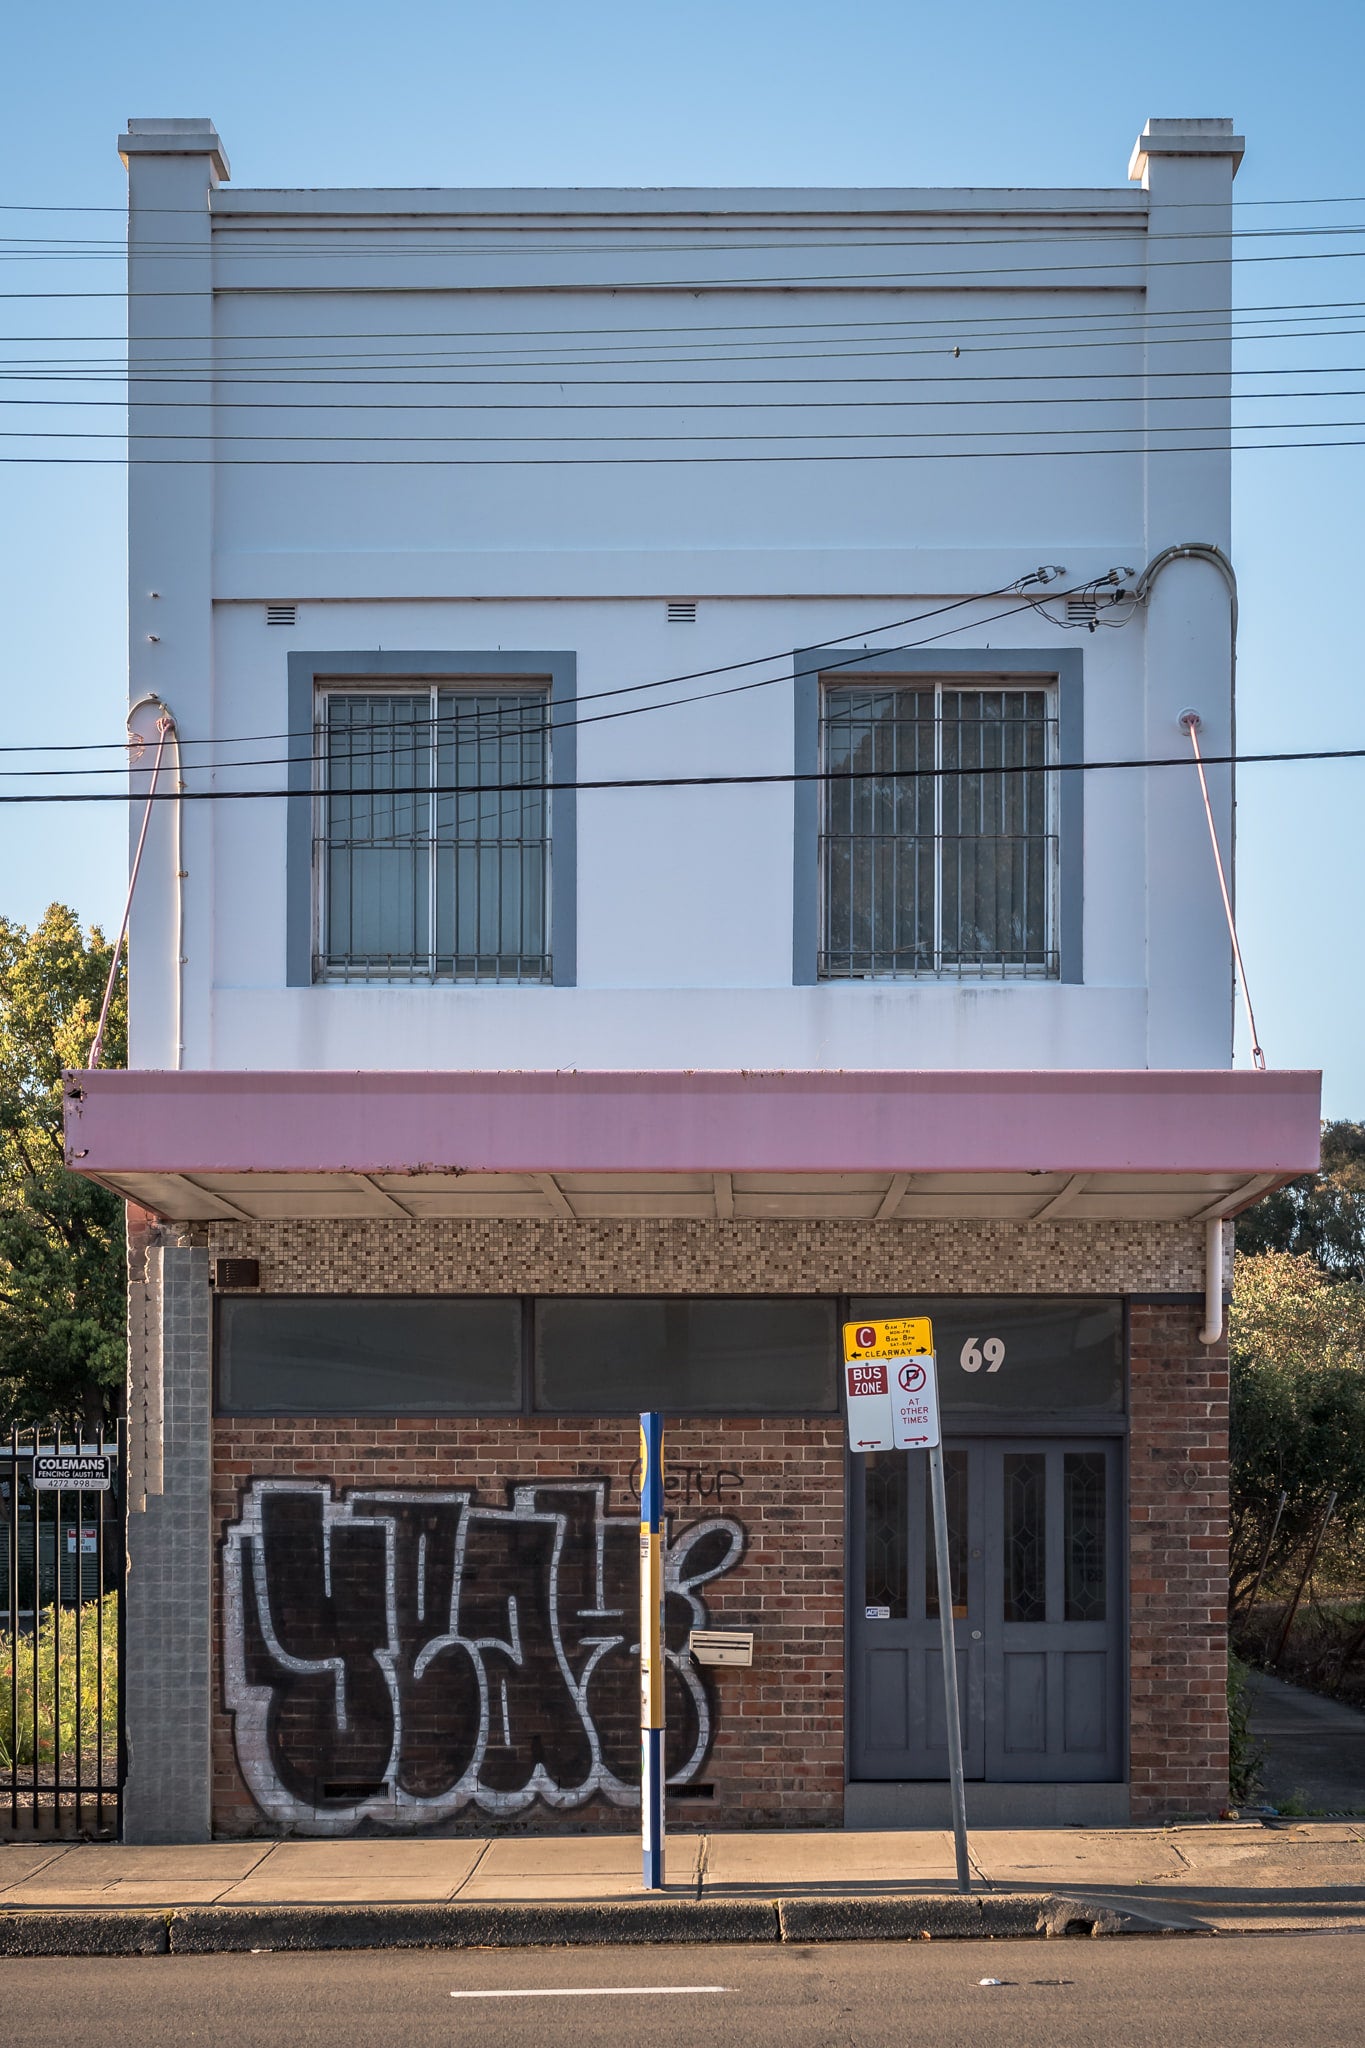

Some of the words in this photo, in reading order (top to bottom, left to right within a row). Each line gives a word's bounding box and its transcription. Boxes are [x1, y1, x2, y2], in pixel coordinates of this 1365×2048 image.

[865, 1348, 913, 1358] CLEARWAY
[960, 1337, 1005, 1373] 69
[853, 1367, 882, 1381] BUS
[854, 1381, 883, 1395] ZONE
[908, 1398, 920, 1406] AT
[900, 1407, 929, 1416] OTHER
[902, 1416, 929, 1424] TIMES
[39, 1459, 105, 1470] COLEMANS
[38, 1470, 70, 1478] FENCING
[72, 1470, 94, 1478] (AUST)
